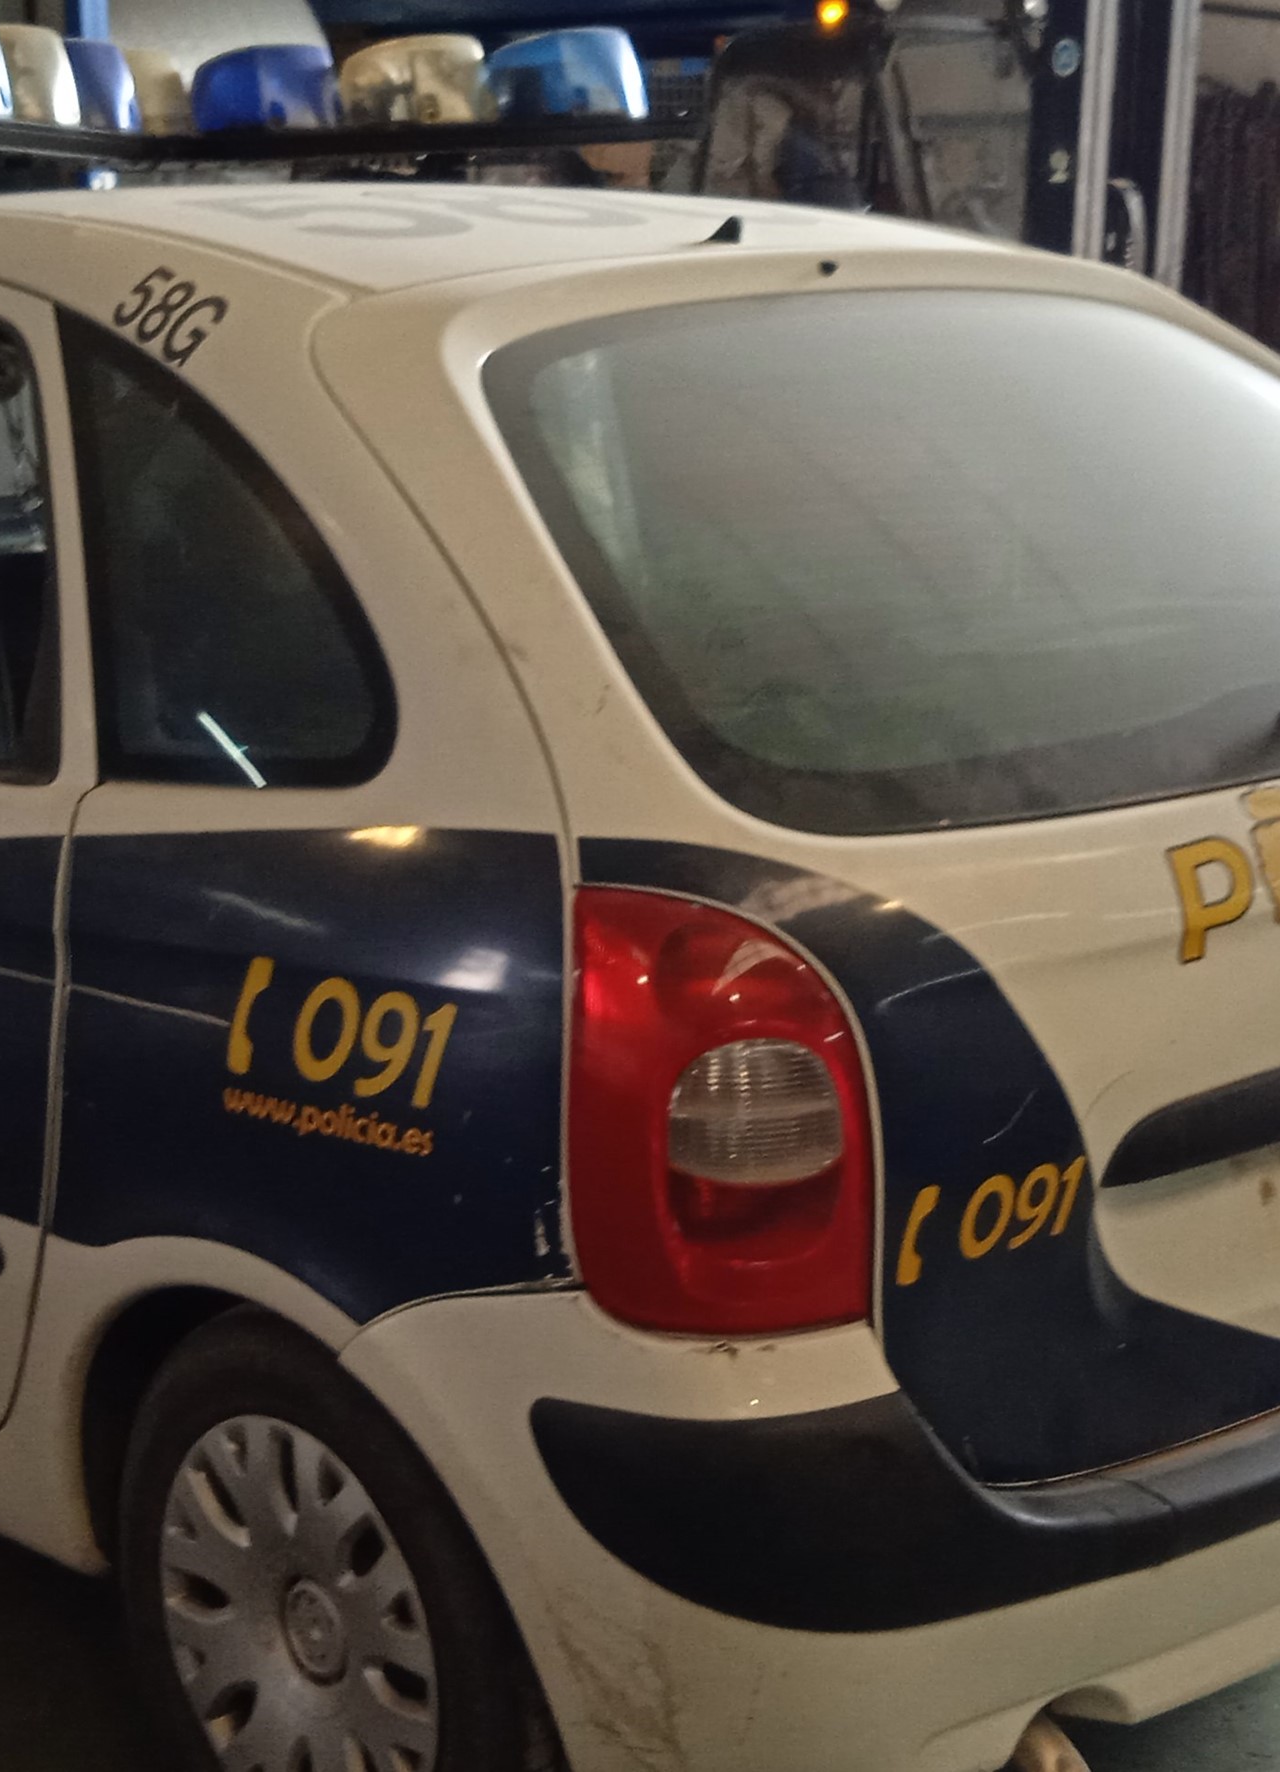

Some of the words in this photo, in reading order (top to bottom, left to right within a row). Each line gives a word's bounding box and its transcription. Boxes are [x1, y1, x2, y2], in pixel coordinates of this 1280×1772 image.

[113, 265, 228, 368] 58G
[293, 976, 458, 1109] 091
[224, 1087, 434, 1157] www.policia.es
[959, 1155, 1087, 1260] 091
